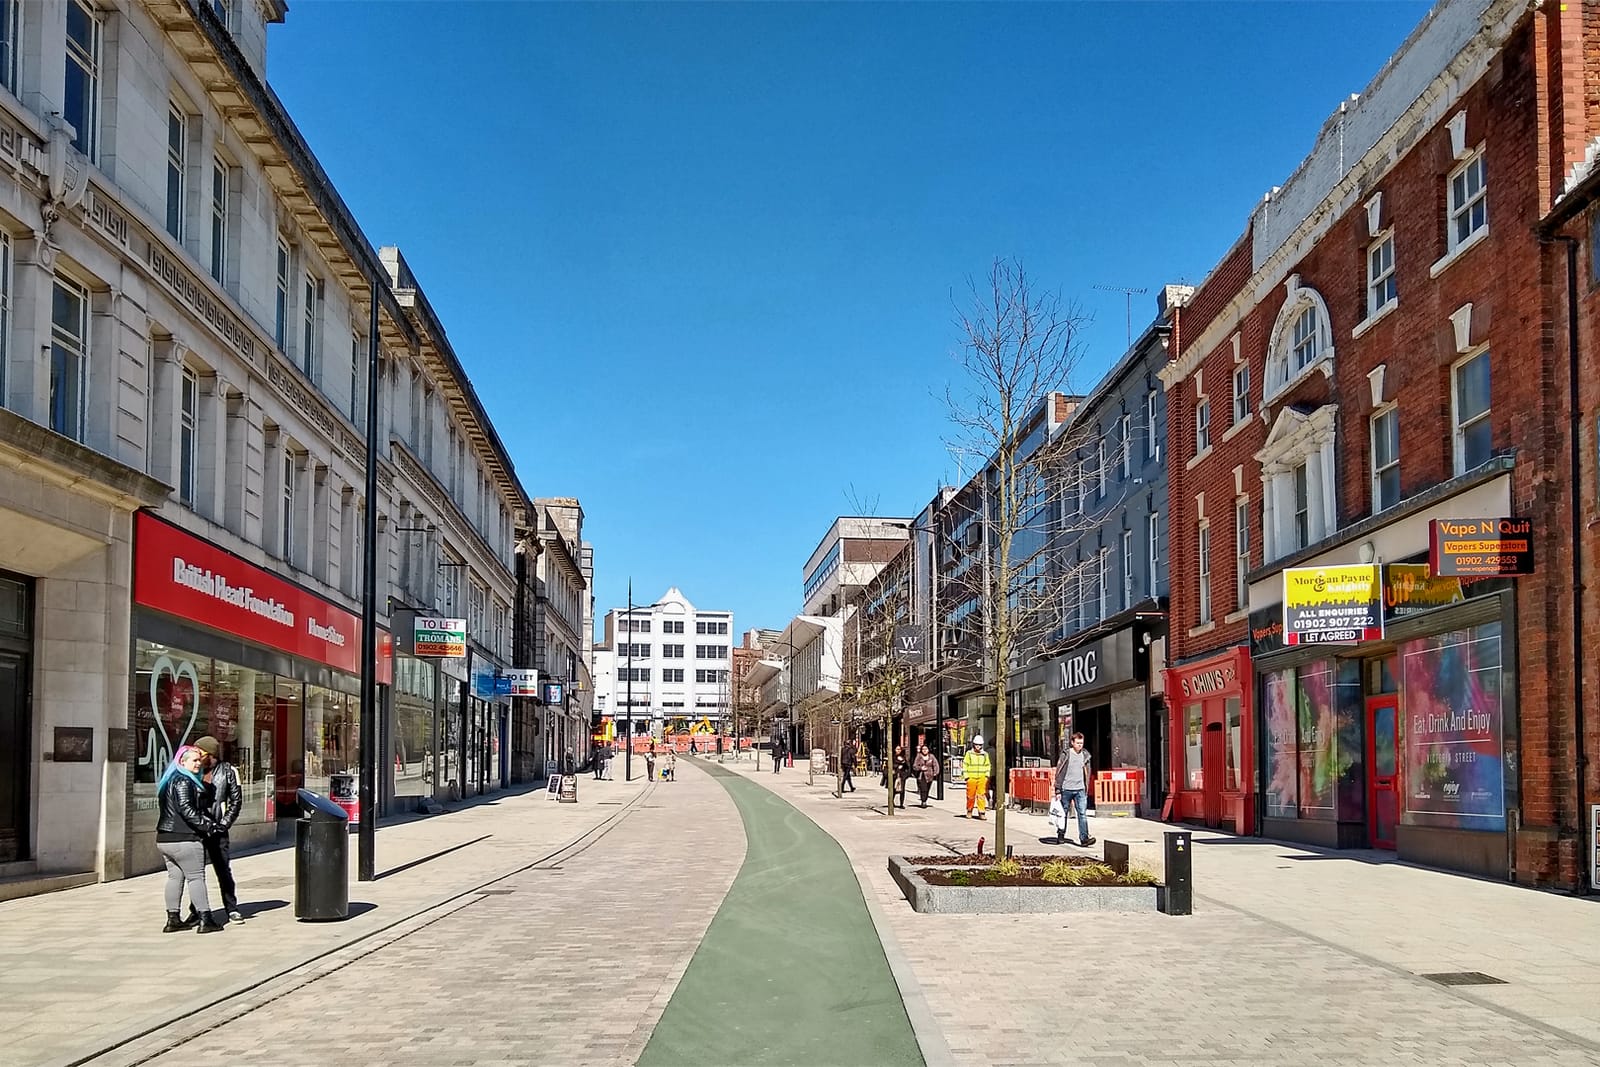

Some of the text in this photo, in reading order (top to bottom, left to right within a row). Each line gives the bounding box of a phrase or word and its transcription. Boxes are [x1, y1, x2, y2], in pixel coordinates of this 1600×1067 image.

[1440, 520, 1530, 537] Vape N Quit
[1446, 541, 1526, 552] Vapers Superstore
[1456, 555, 1517, 565] 01902 429553
[1341, 574, 1371, 583] Payne
[174, 557, 294, 627] British Heart Foundation
[1299, 607, 1369, 618] ALL ENQUIRIES
[422, 619, 459, 630] TO LET
[1293, 616, 1374, 629] 01902 907 222
[901, 636, 918, 649] W
[1305, 631, 1356, 642] LET AGREED
[1060, 650, 1097, 690] MRG
[1181, 679, 1190, 697] S
[1192, 669, 1225, 695] CHIN'S
[1413, 709, 1491, 735] Eat, Drink And Enjoy
[1455, 751, 1476, 763] STREET
